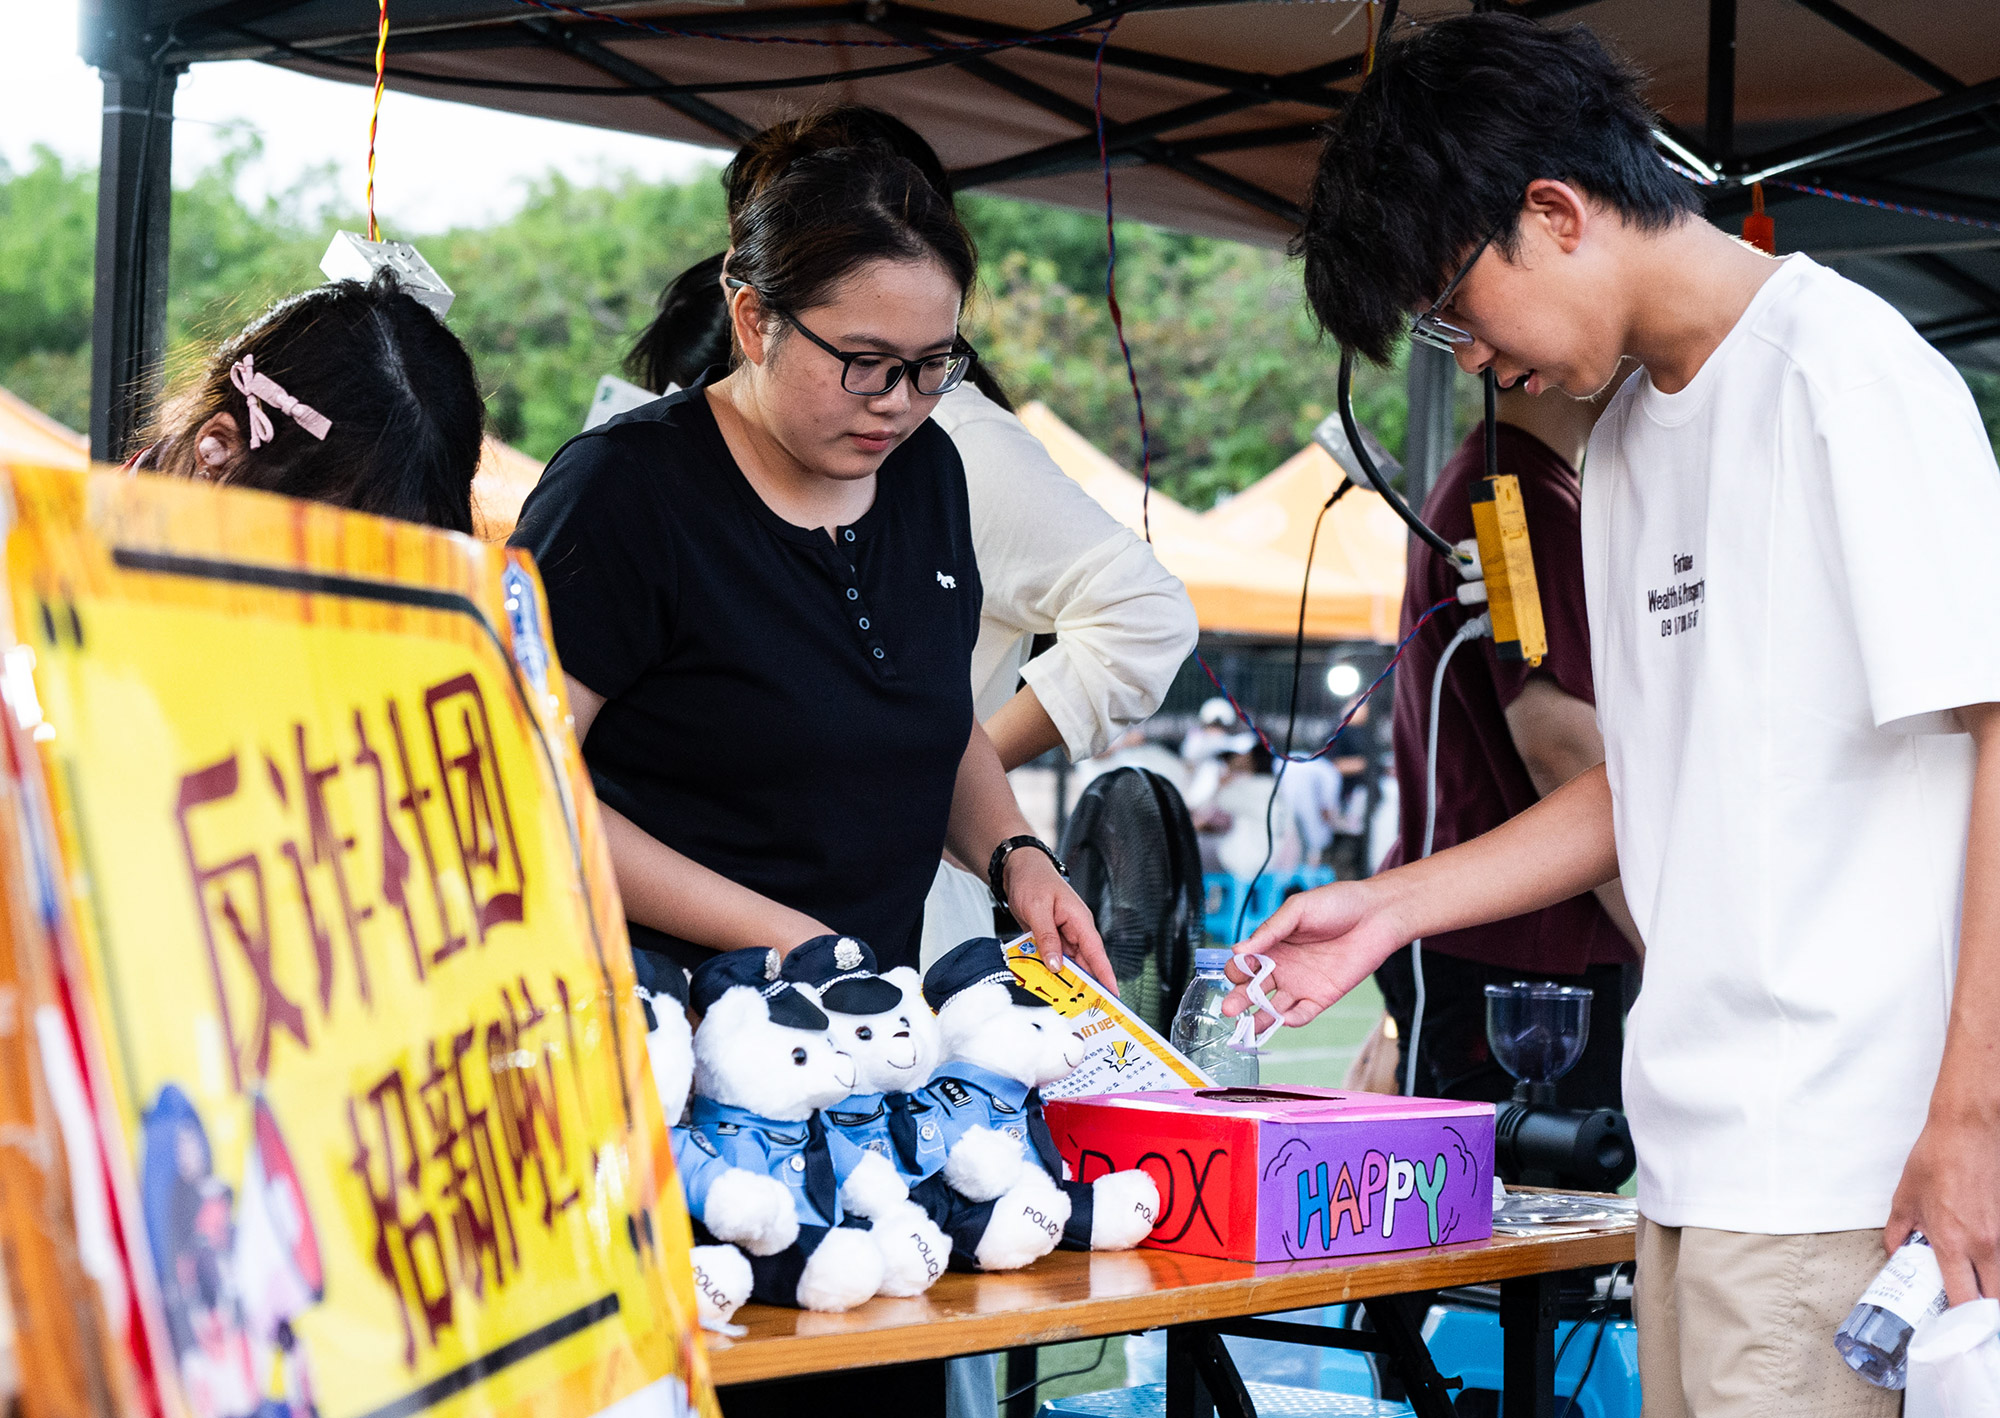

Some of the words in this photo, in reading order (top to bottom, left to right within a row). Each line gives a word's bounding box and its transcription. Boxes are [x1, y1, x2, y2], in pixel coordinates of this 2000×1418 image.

[1648, 585, 1678, 613] Wealth
[1661, 618, 1672, 637] 09
[177, 672, 525, 1094] 反诈社团
[1298, 1149, 1448, 1251] HAPPY
[910, 1233, 939, 1282] POLICE
[693, 1265, 731, 1311] POLICE
